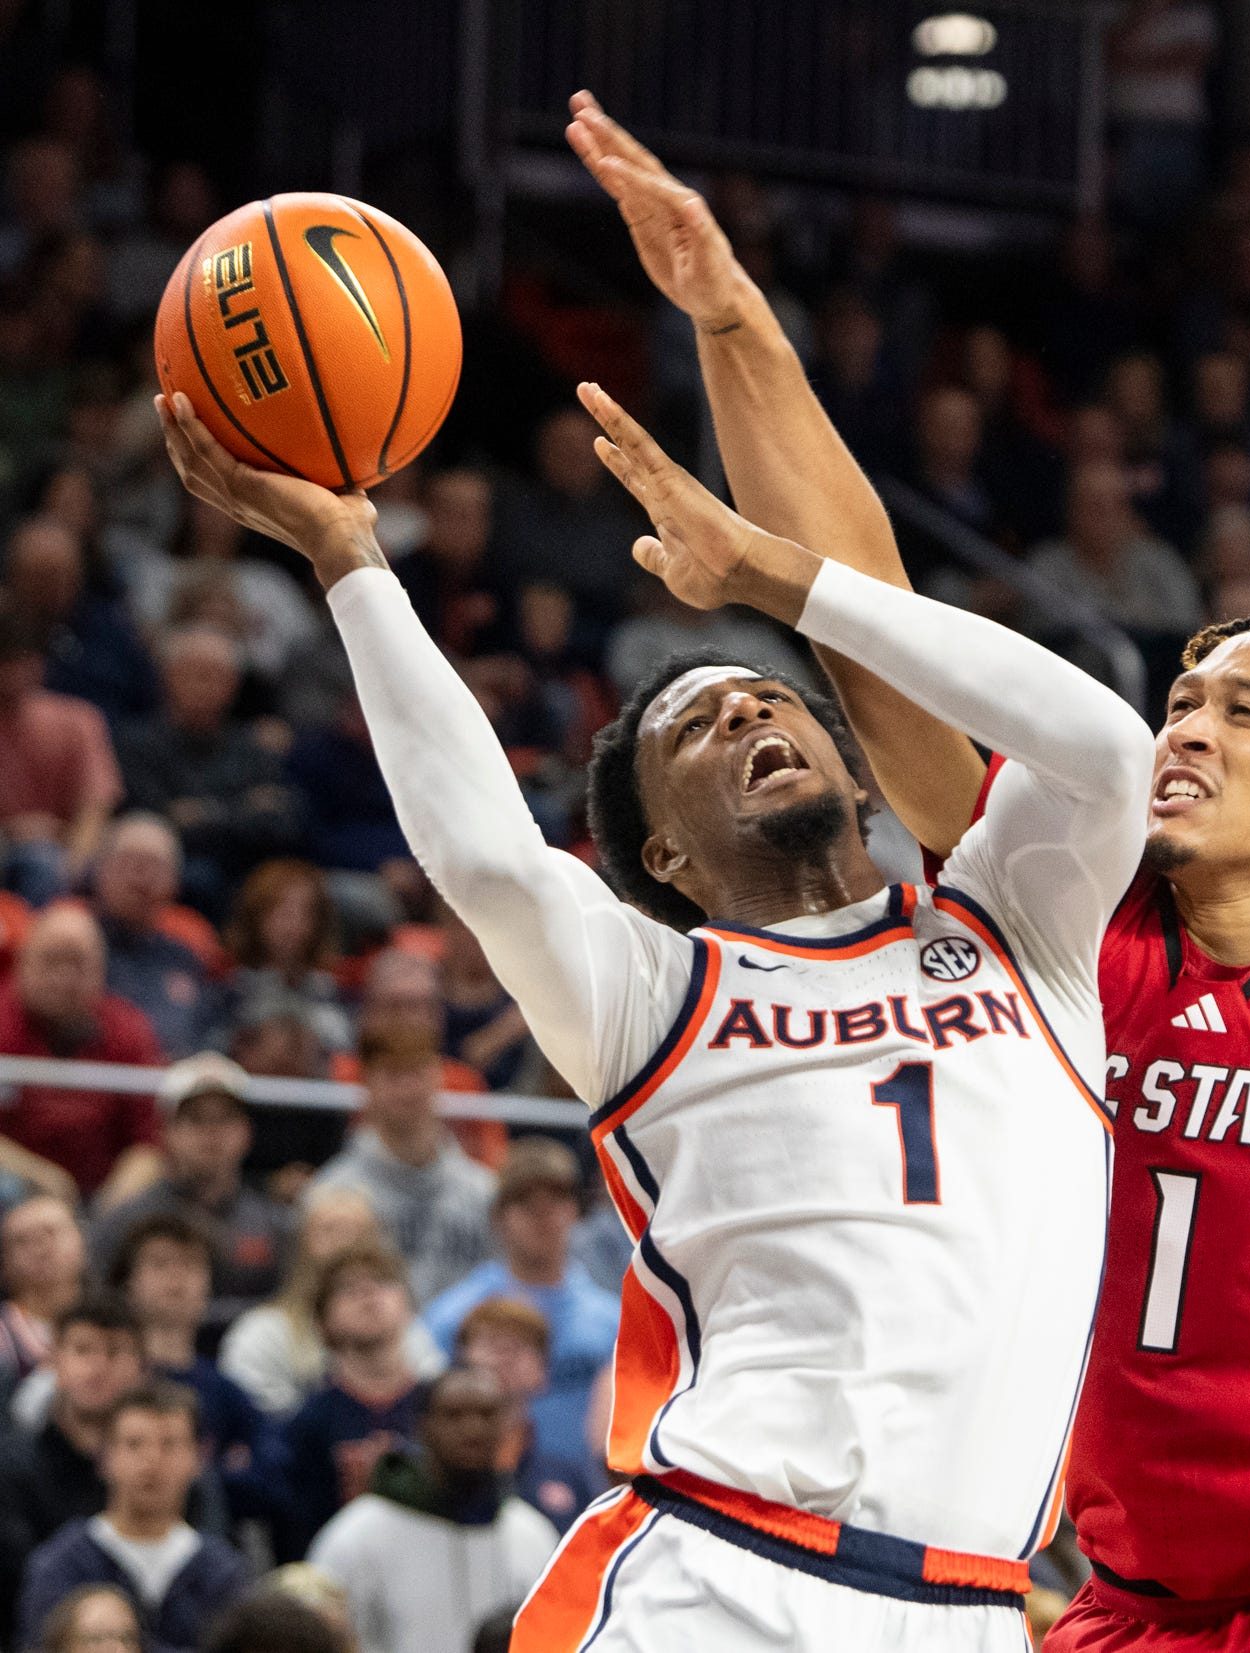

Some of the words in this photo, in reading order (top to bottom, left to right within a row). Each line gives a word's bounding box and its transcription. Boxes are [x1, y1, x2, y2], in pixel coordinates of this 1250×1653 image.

[214, 242, 289, 400] ELITE
[922, 939, 978, 981] SEC
[870, 1060, 943, 1206] 1
[1136, 1166, 1203, 1355] 1
